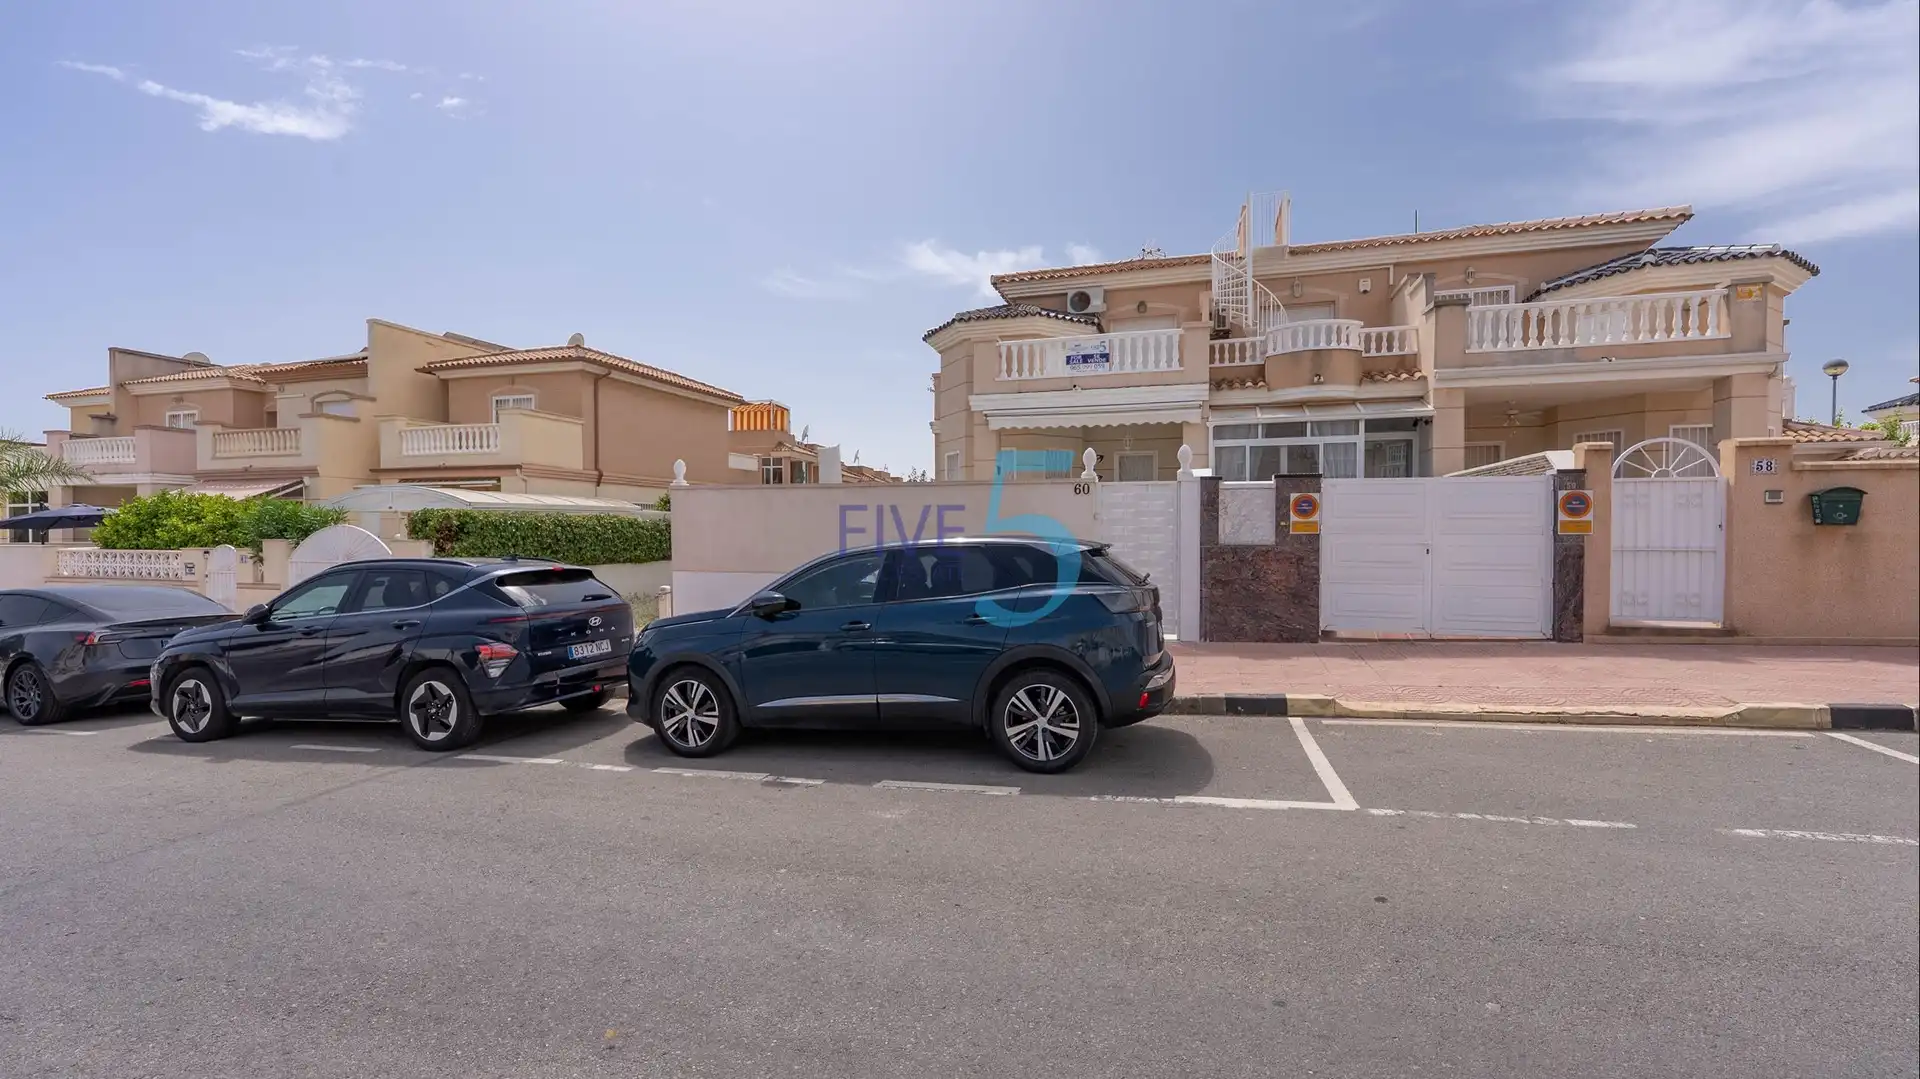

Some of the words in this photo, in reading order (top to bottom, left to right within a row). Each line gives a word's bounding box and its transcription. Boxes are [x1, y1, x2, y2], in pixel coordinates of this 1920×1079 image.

[1755, 460, 1774, 472] 58
[1074, 483, 1090, 495] 60
[573, 643, 595, 656] 8312
[595, 640, 610, 652] NCJ
